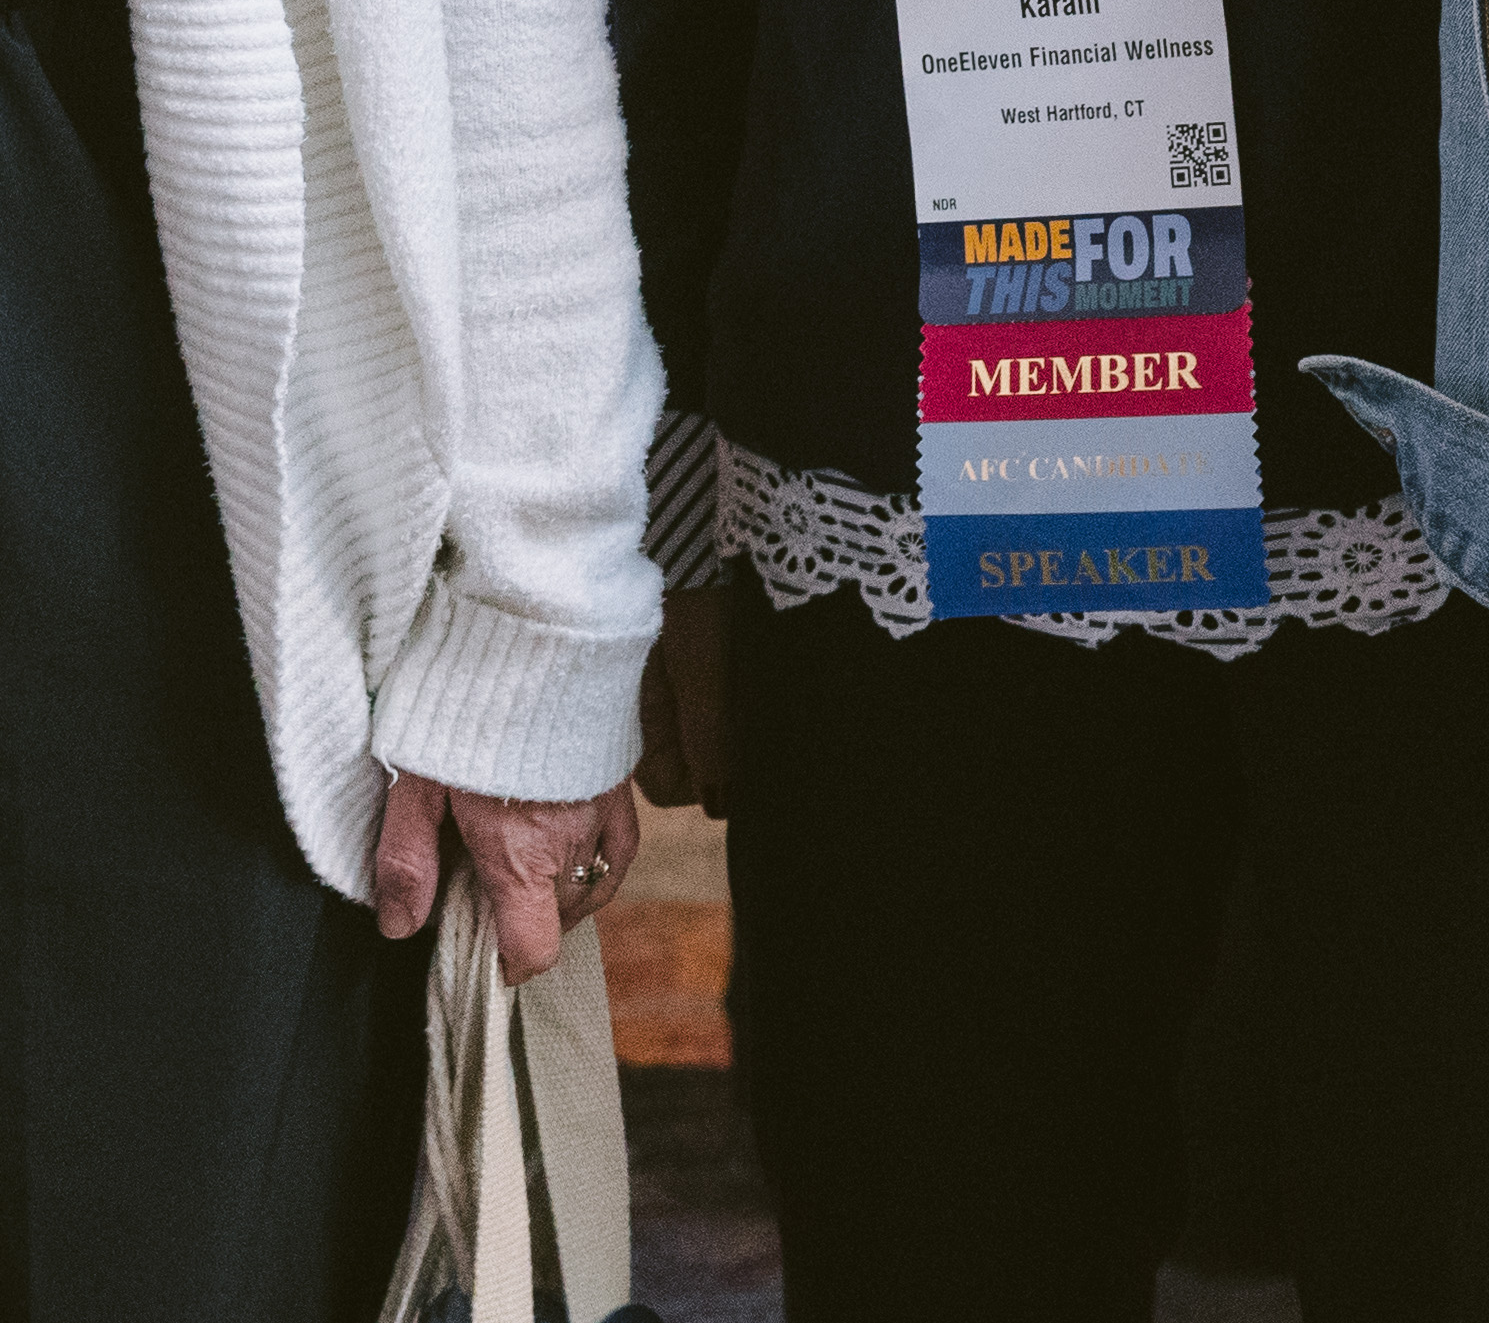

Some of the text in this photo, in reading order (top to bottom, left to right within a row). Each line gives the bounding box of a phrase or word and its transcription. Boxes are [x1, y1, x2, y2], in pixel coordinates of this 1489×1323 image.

[922, 38, 1215, 75] OneEleven Financial Wellness
[1000, 100, 1145, 125] West Hartford, CT
[932, 198, 957, 211] NDR
[963, 213, 1194, 282] MADE FOR
[964, 262, 1194, 315] THIS MOMENT
[967, 351, 1203, 398] MEMBER
[958, 457, 1020, 482] AFC
[979, 545, 1217, 589] SPEAKER
